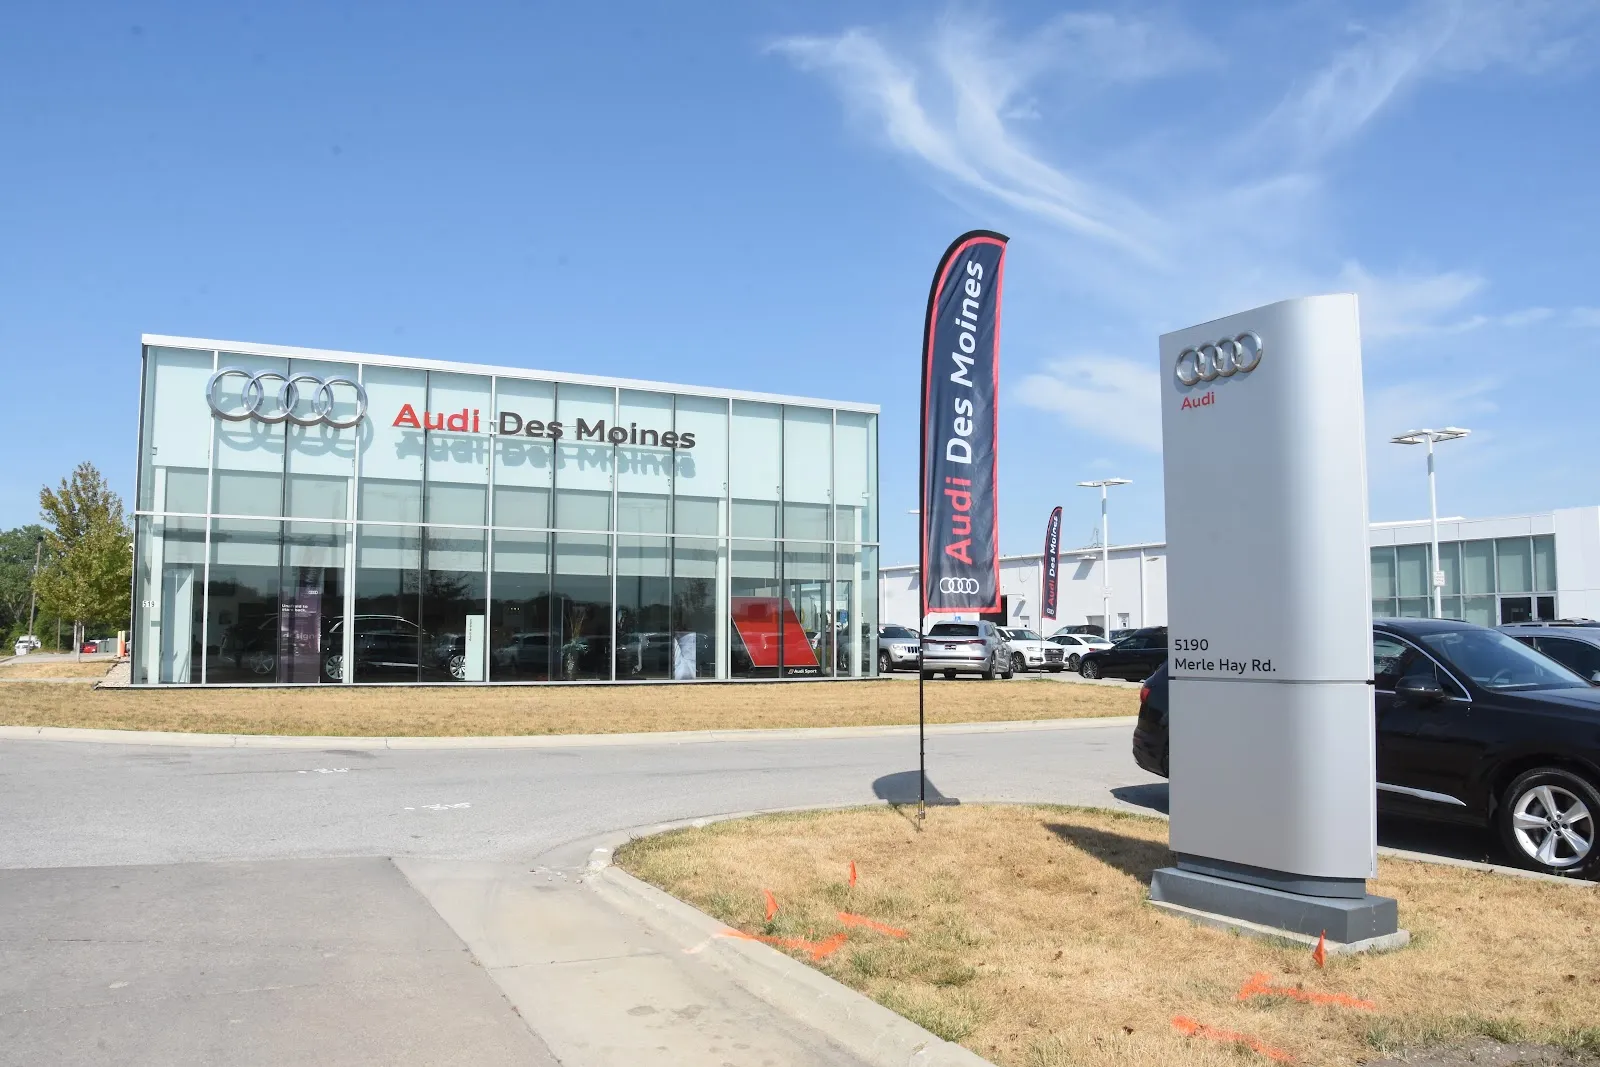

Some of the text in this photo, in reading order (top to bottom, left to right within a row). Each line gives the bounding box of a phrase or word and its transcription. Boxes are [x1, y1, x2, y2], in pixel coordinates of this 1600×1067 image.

[944, 259, 984, 565] Audi Des Moines
[1181, 391, 1215, 411] Audi
[392, 403, 696, 449] Audi Des Moines
[1050, 516, 1058, 554] Moines
[1174, 639, 1209, 651] 5190
[1175, 658, 1276, 675] Merle Hay Rd.
